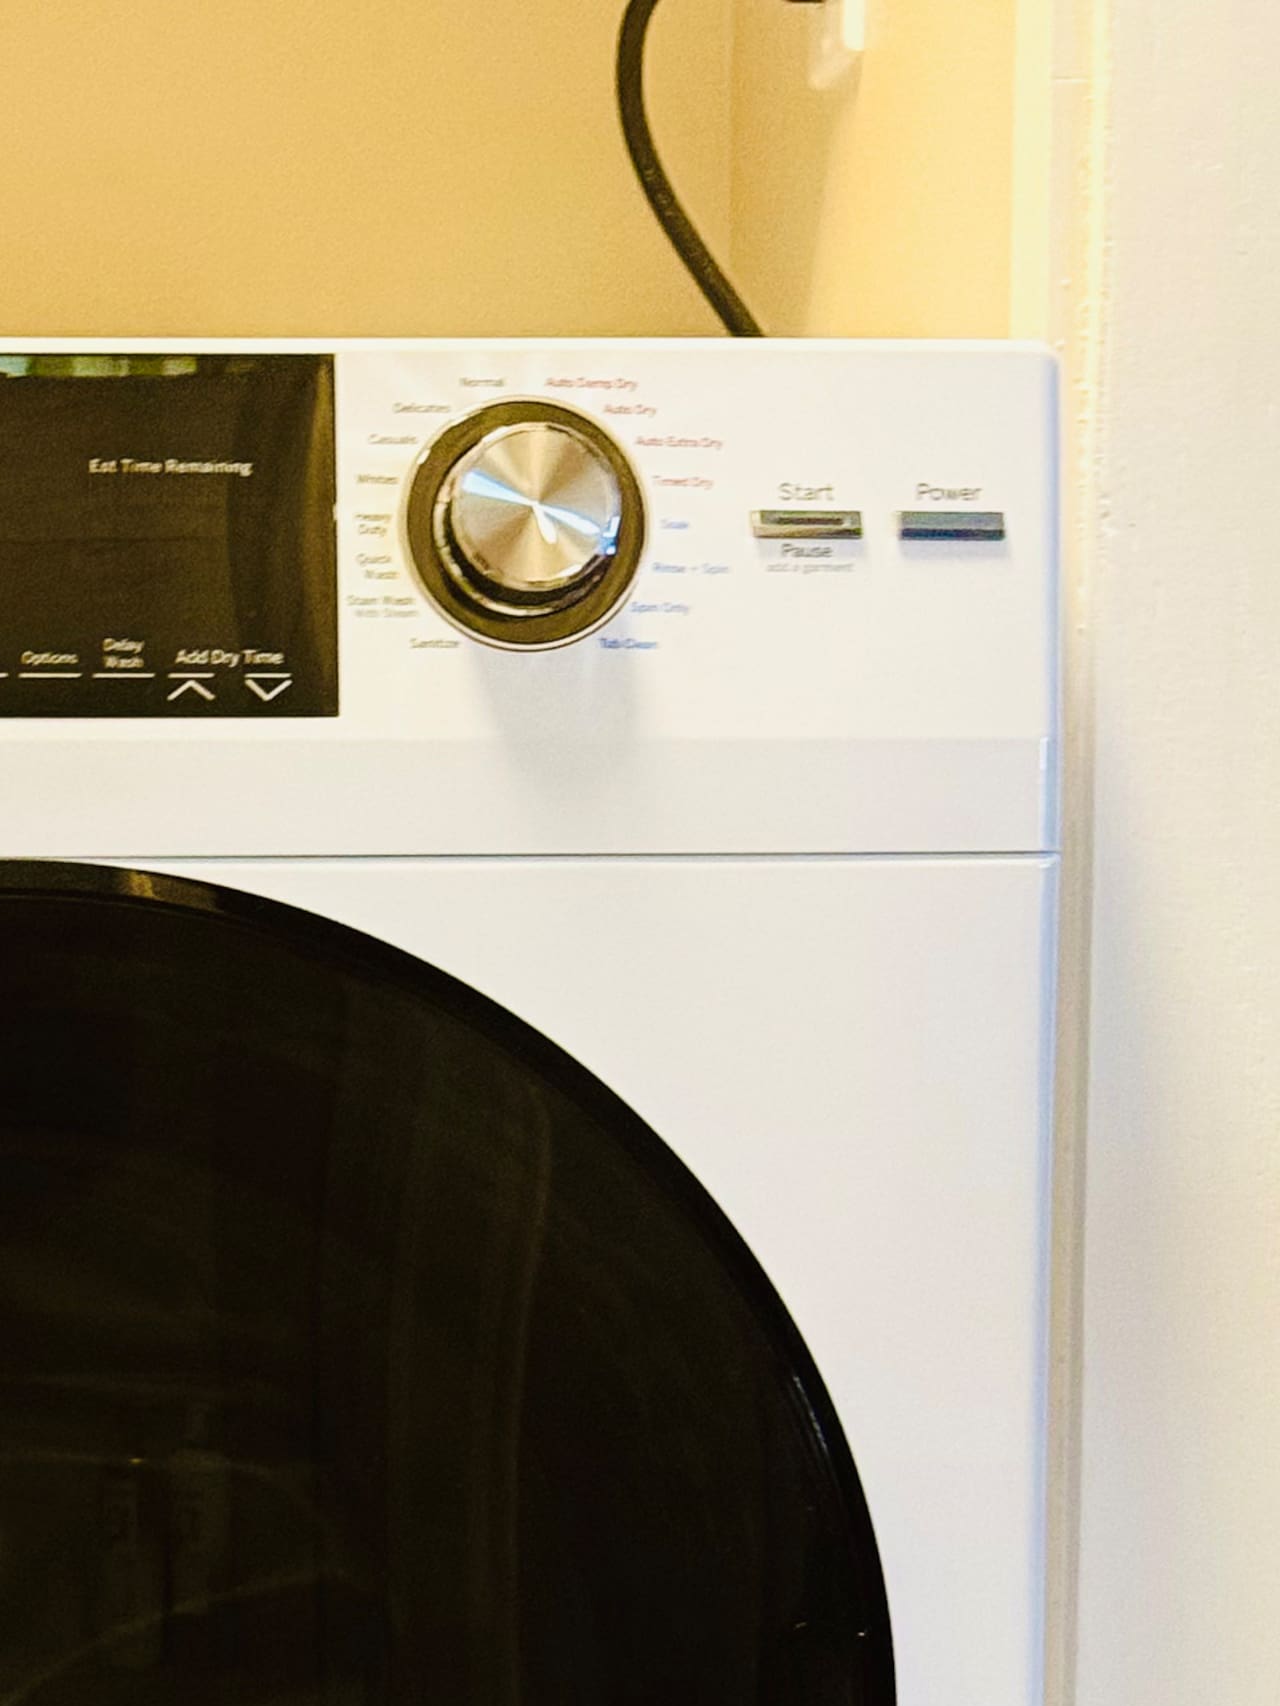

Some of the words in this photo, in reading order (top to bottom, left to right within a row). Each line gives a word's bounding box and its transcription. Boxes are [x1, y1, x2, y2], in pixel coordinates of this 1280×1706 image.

[545, 377, 573, 387] Auto
[615, 378, 638, 391] Dry
[604, 404, 632, 414] Auto
[635, 404, 657, 417] Dry
[636, 436, 663, 446] Auto
[701, 437, 723, 450] Dry
[120, 457, 163, 473] Time
[164, 457, 254, 477] Remaining
[691, 476, 713, 490] Dry
[777, 482, 835, 501] Start
[915, 483, 983, 501] Power
[781, 543, 832, 558] Pause
[102, 638, 145, 654] Delay
[21, 651, 79, 667] Options
[103, 656, 145, 668] Wash
[174, 650, 209, 665] Add
[210, 649, 240, 667] Dry
[242, 649, 285, 665] Time
